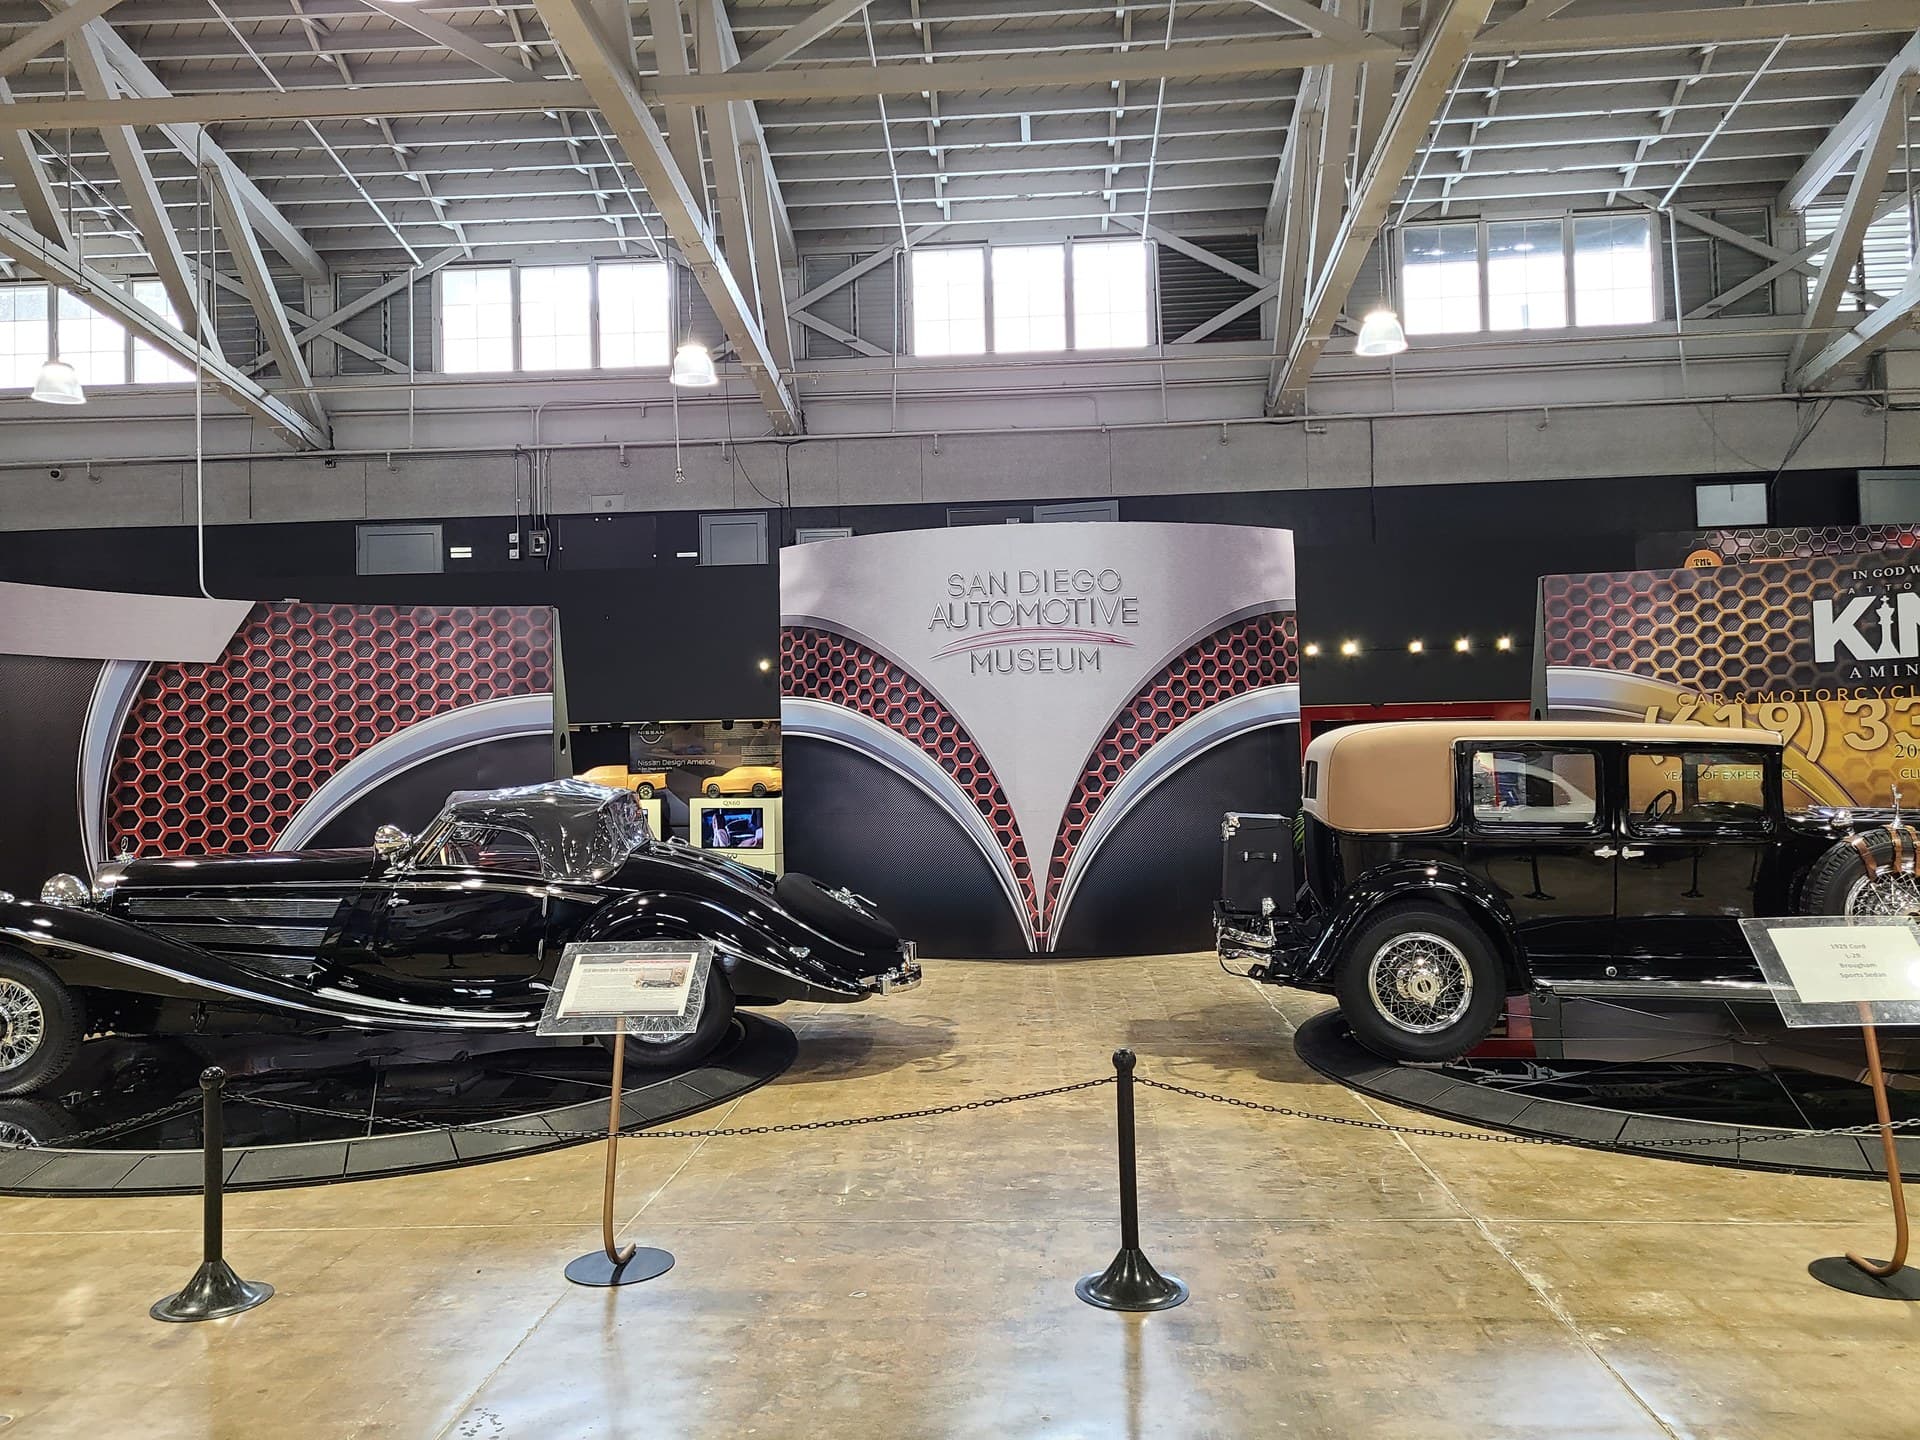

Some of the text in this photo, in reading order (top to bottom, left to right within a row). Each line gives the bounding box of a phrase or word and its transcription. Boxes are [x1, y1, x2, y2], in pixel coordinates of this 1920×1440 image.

[1852, 570, 1868, 580] IN
[1872, 566, 1905, 579] GOD
[947, 568, 1122, 597] SAN DIEGO
[928, 596, 1139, 631] AUTOMOTIVE
[969, 647, 1101, 674] MUSEUM
[1677, 692, 1725, 707] CAR
[1734, 691, 1747, 705] &
[637, 758, 716, 767] Nissan Design America
[1702, 769, 1798, 780] OF EXPERCE
